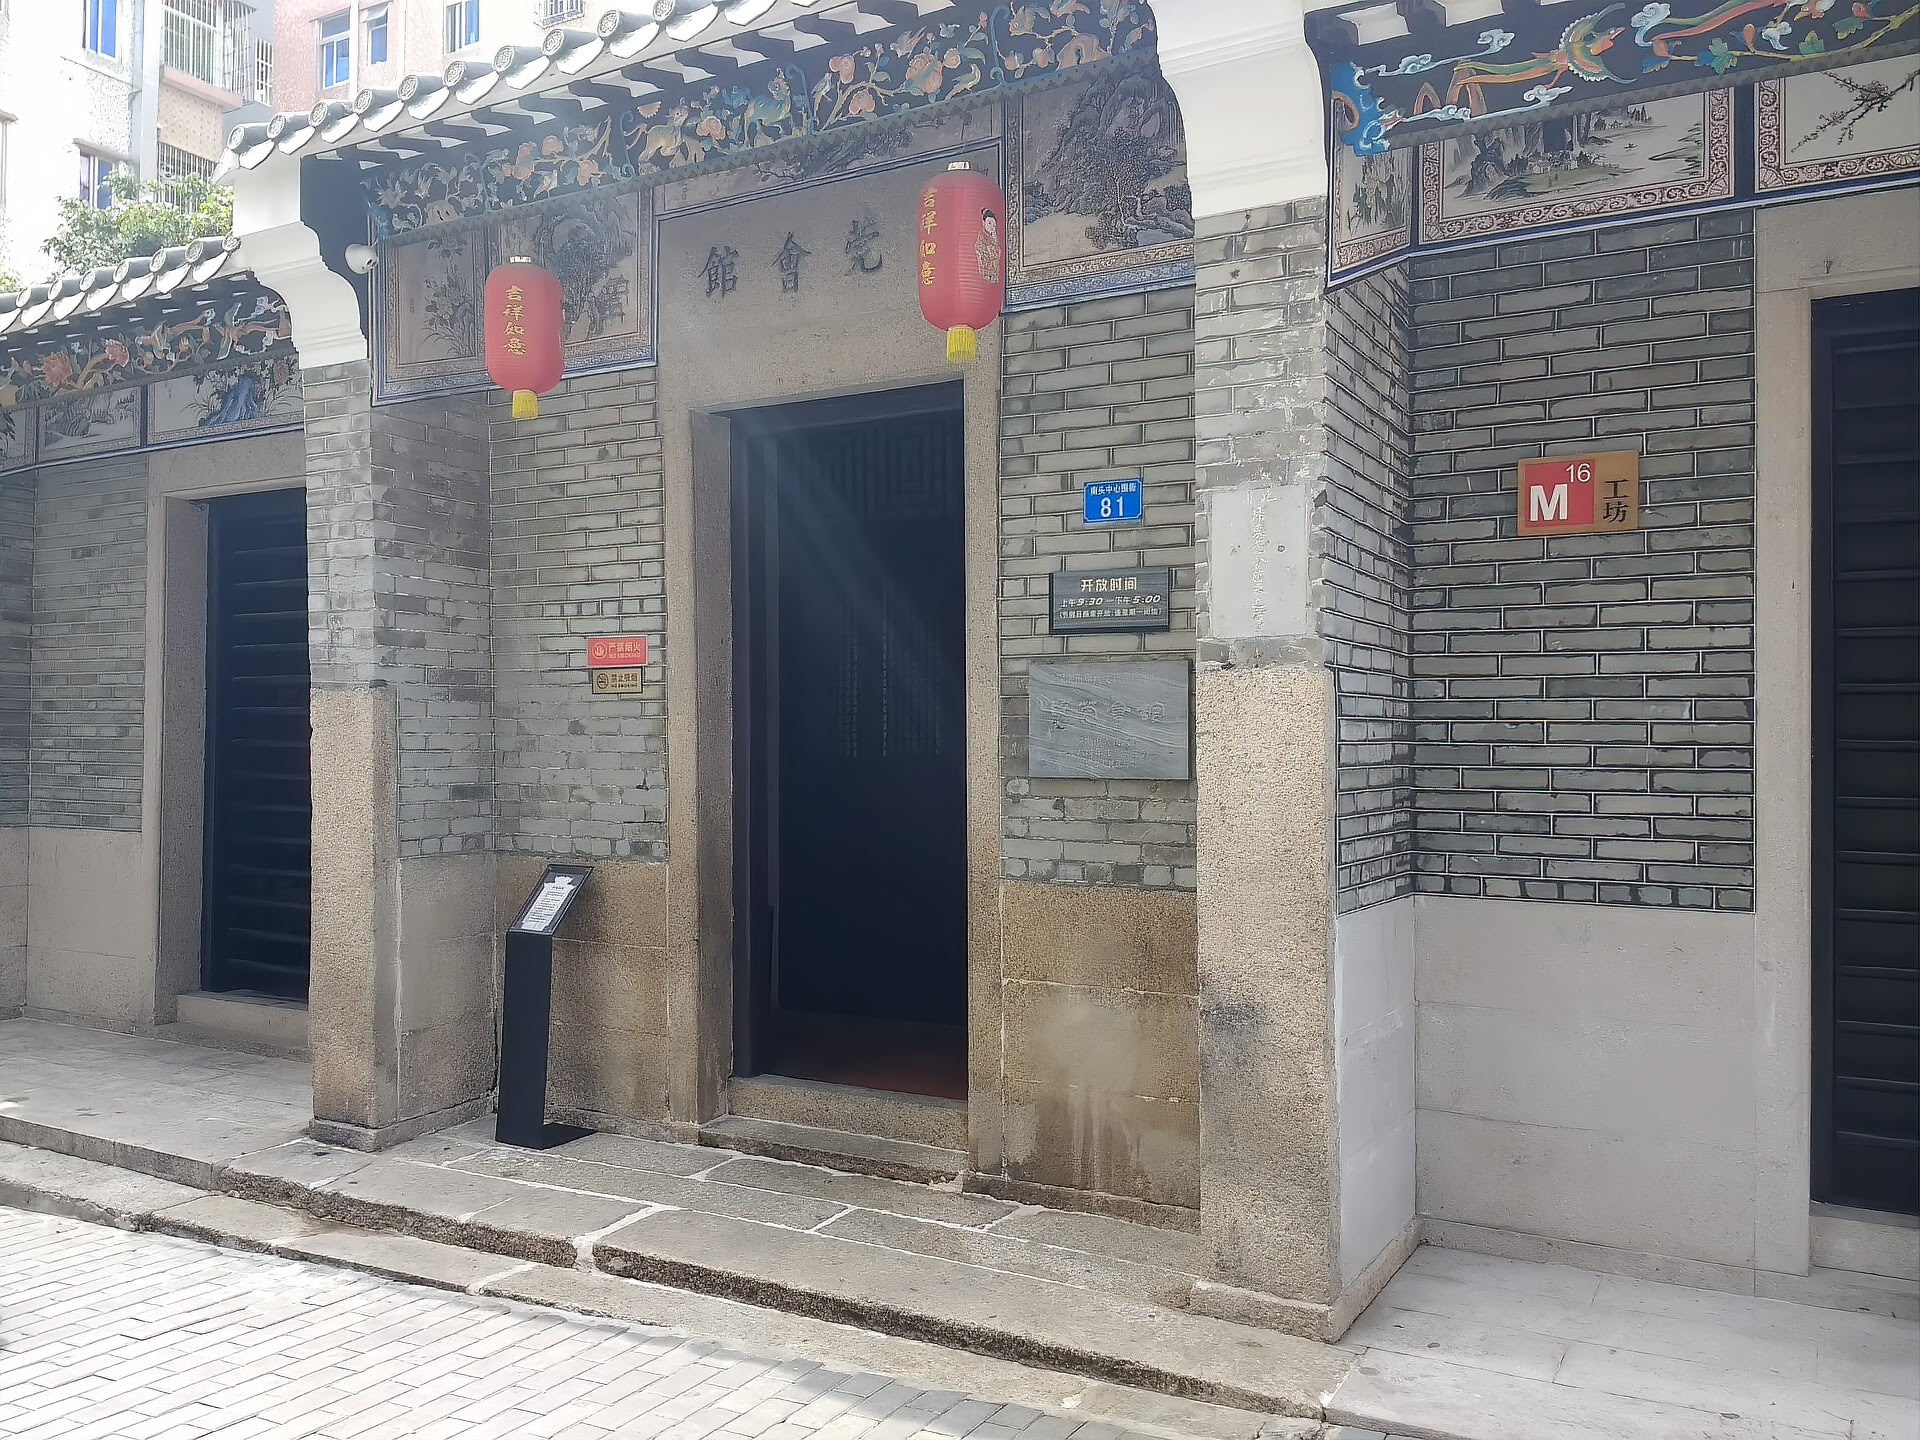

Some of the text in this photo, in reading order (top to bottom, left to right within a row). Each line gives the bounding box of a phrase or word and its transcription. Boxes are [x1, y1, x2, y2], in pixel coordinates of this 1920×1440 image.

[503, 285, 527, 355] 吉祥如意
[1100, 496, 1124, 518] 81
[1530, 463, 1591, 522] M 16
[1603, 479, 1629, 523] 工坊
[1080, 576, 1138, 592] 开放时间
